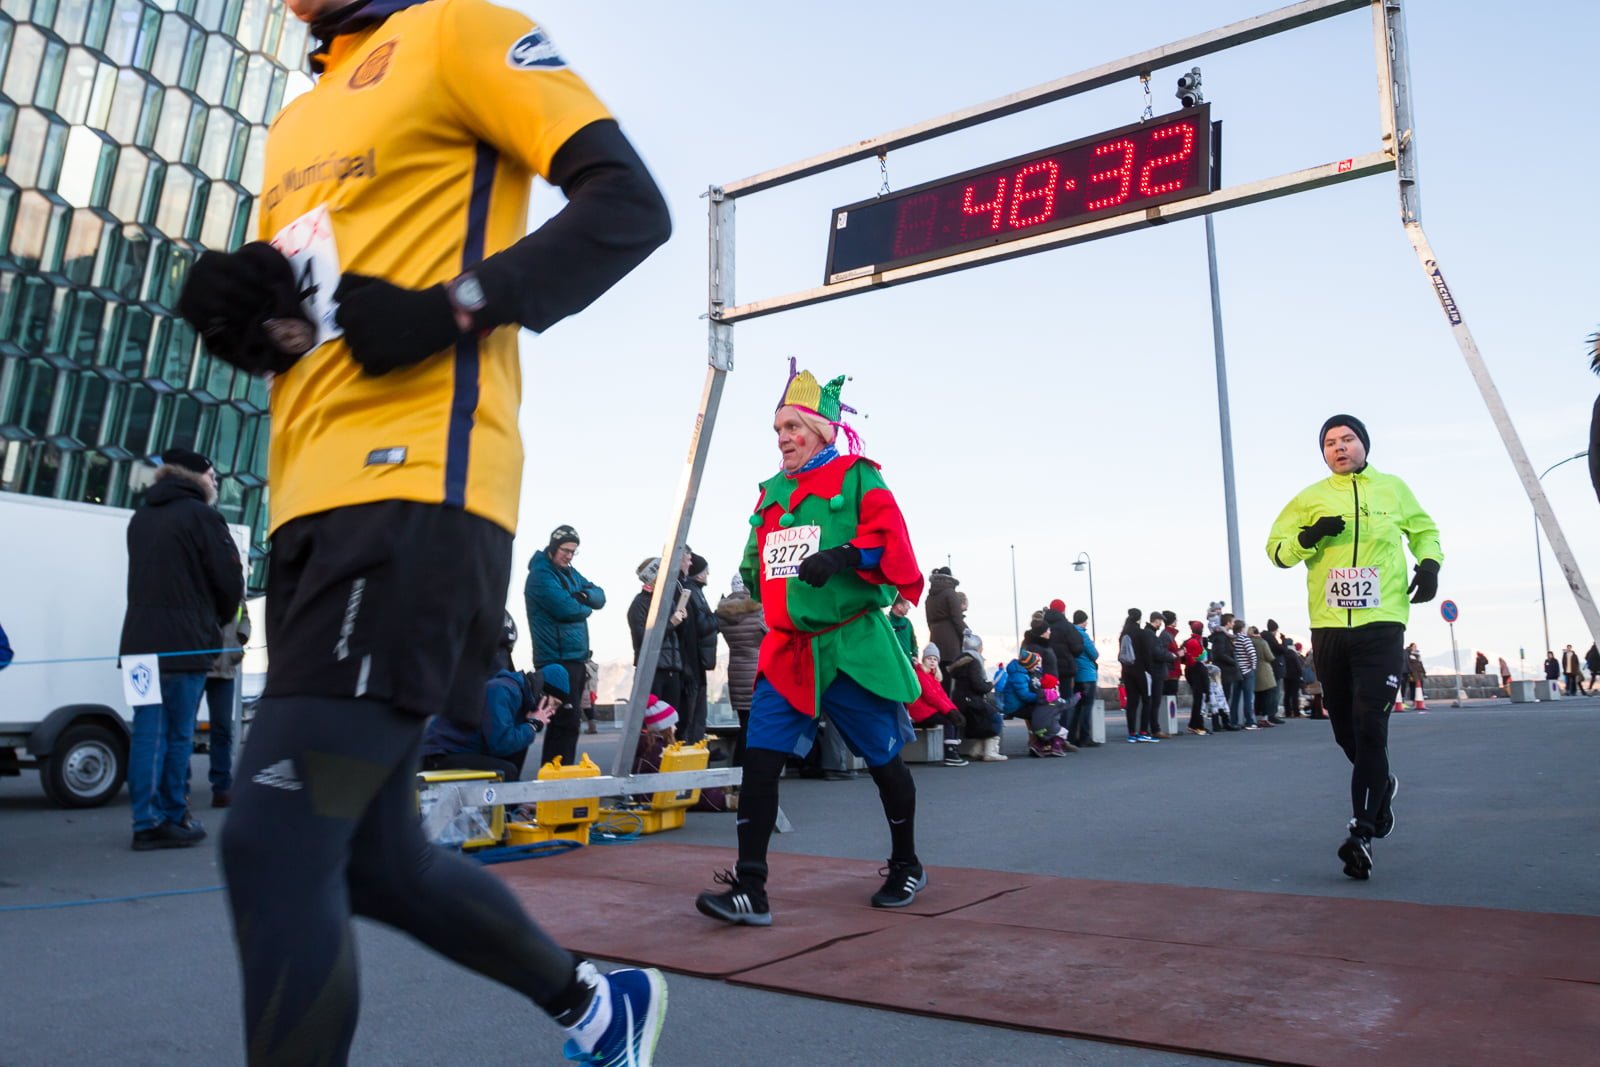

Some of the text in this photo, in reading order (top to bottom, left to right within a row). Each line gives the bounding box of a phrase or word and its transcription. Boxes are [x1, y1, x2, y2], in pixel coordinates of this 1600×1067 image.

[1432, 275, 1460, 321] MICHELIN
[766, 527, 818, 546] LINDEX
[767, 543, 810, 564] 3272
[1330, 581, 1373, 597] 4812
